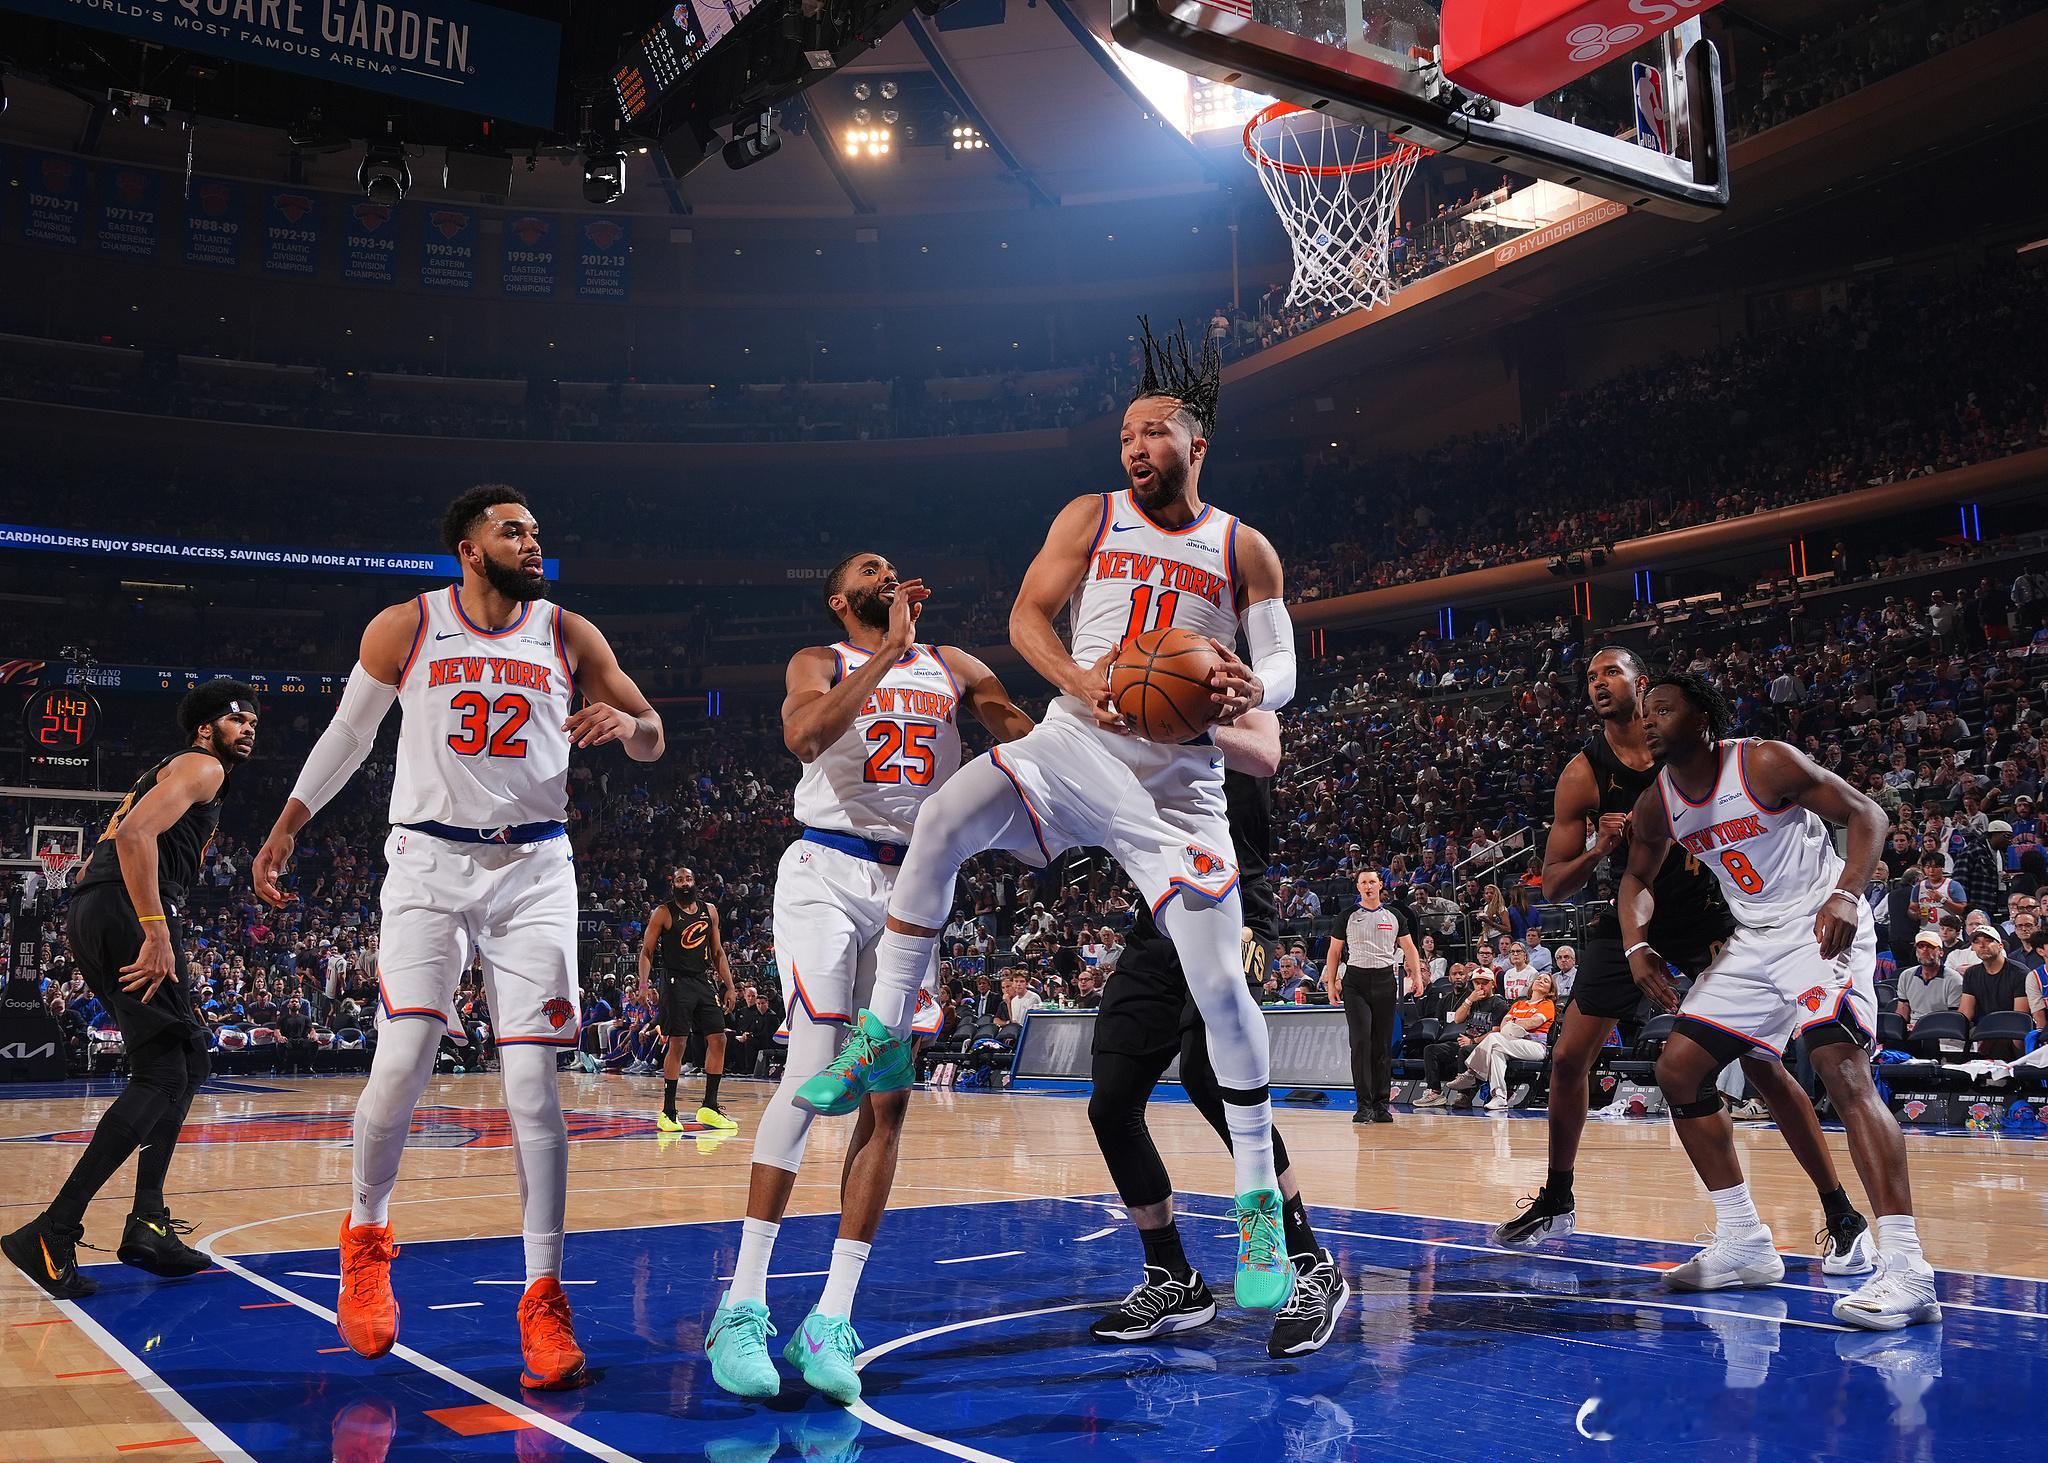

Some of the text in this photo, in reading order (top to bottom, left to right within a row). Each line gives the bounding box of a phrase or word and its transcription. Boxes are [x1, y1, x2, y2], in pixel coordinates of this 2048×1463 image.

[174, 15, 231, 37] MOST
[240, 31, 321, 58] FAMOUS
[660, 28, 668, 39] 10
[684, 30, 697, 47] 46
[30, 193, 79, 212] 1970-71
[32, 210, 74, 225] ATLANTIC
[104, 206, 154, 223] 1971-72
[33, 219, 71, 234] DIVISION
[107, 222, 148, 236] EASTERN
[187, 217, 240, 235] 1988-89
[1519, 203, 1625, 253] HYUNDAI BRIDGE
[25, 228, 78, 245] CHAMPIONS
[99, 230, 157, 246] CONFERENCE
[191, 232, 233, 246] ATLANTIC
[268, 226, 317, 243] 1992-93
[101, 240, 152, 256] CHAMPIONS
[193, 243, 231, 255] DIVISION
[271, 240, 313, 253] ATLANTIC
[348, 236, 394, 251] 1993-94
[426, 243, 473, 259] 1993-94
[186, 251, 237, 266] CHAMPIONS
[272, 250, 310, 263] DIVISION
[350, 250, 388, 262] ATLANTIC
[429, 257, 465, 270] EASTERN
[507, 250, 553, 265] 1998-99
[581, 254, 626, 268] 2012-13
[265, 258, 315, 274] CHAMPIONS
[351, 260, 386, 272] DIVISION
[421, 266, 473, 279] CONFERENCE
[511, 264, 547, 275] EASTERN
[584, 268, 622, 279] ATLANTIC
[344, 269, 392, 281] CHAMPIONS
[423, 276, 470, 289] CHAMPIONS
[503, 273, 554, 286] CONFERENCE
[506, 282, 551, 295] CHAMPIONS
[586, 277, 619, 289] DIVISION
[579, 286, 625, 298] CHAMPIONS
[0, 531, 434, 571] CARDHOLDERS ENJOY SPECIAL ACCESS, SAVINGS AND MORE AT THE GARDEN
[787, 568, 816, 580] BUD
[1097, 551, 1226, 610] NEW YORK
[1119, 583, 1181, 652] 11
[429, 656, 552, 695] NEW YORK
[161, 680, 169, 689] 0
[281, 684, 306, 693] 80.0
[320, 685, 332, 694] 11
[46, 695, 87, 716] 11:43
[861, 688, 954, 725] EW YORK
[40, 715, 82, 745] 24
[447, 690, 532, 758] 32
[863, 719, 938, 787] 25
[48, 756, 90, 767] TISSOT
[1711, 814, 1768, 846] YORK
[1720, 848, 1764, 895] 8
[579, 920, 607, 932] TRA
[20, 942, 35, 954] GET
[20, 955, 35, 966] THE
[5, 999, 41, 1011] Google
